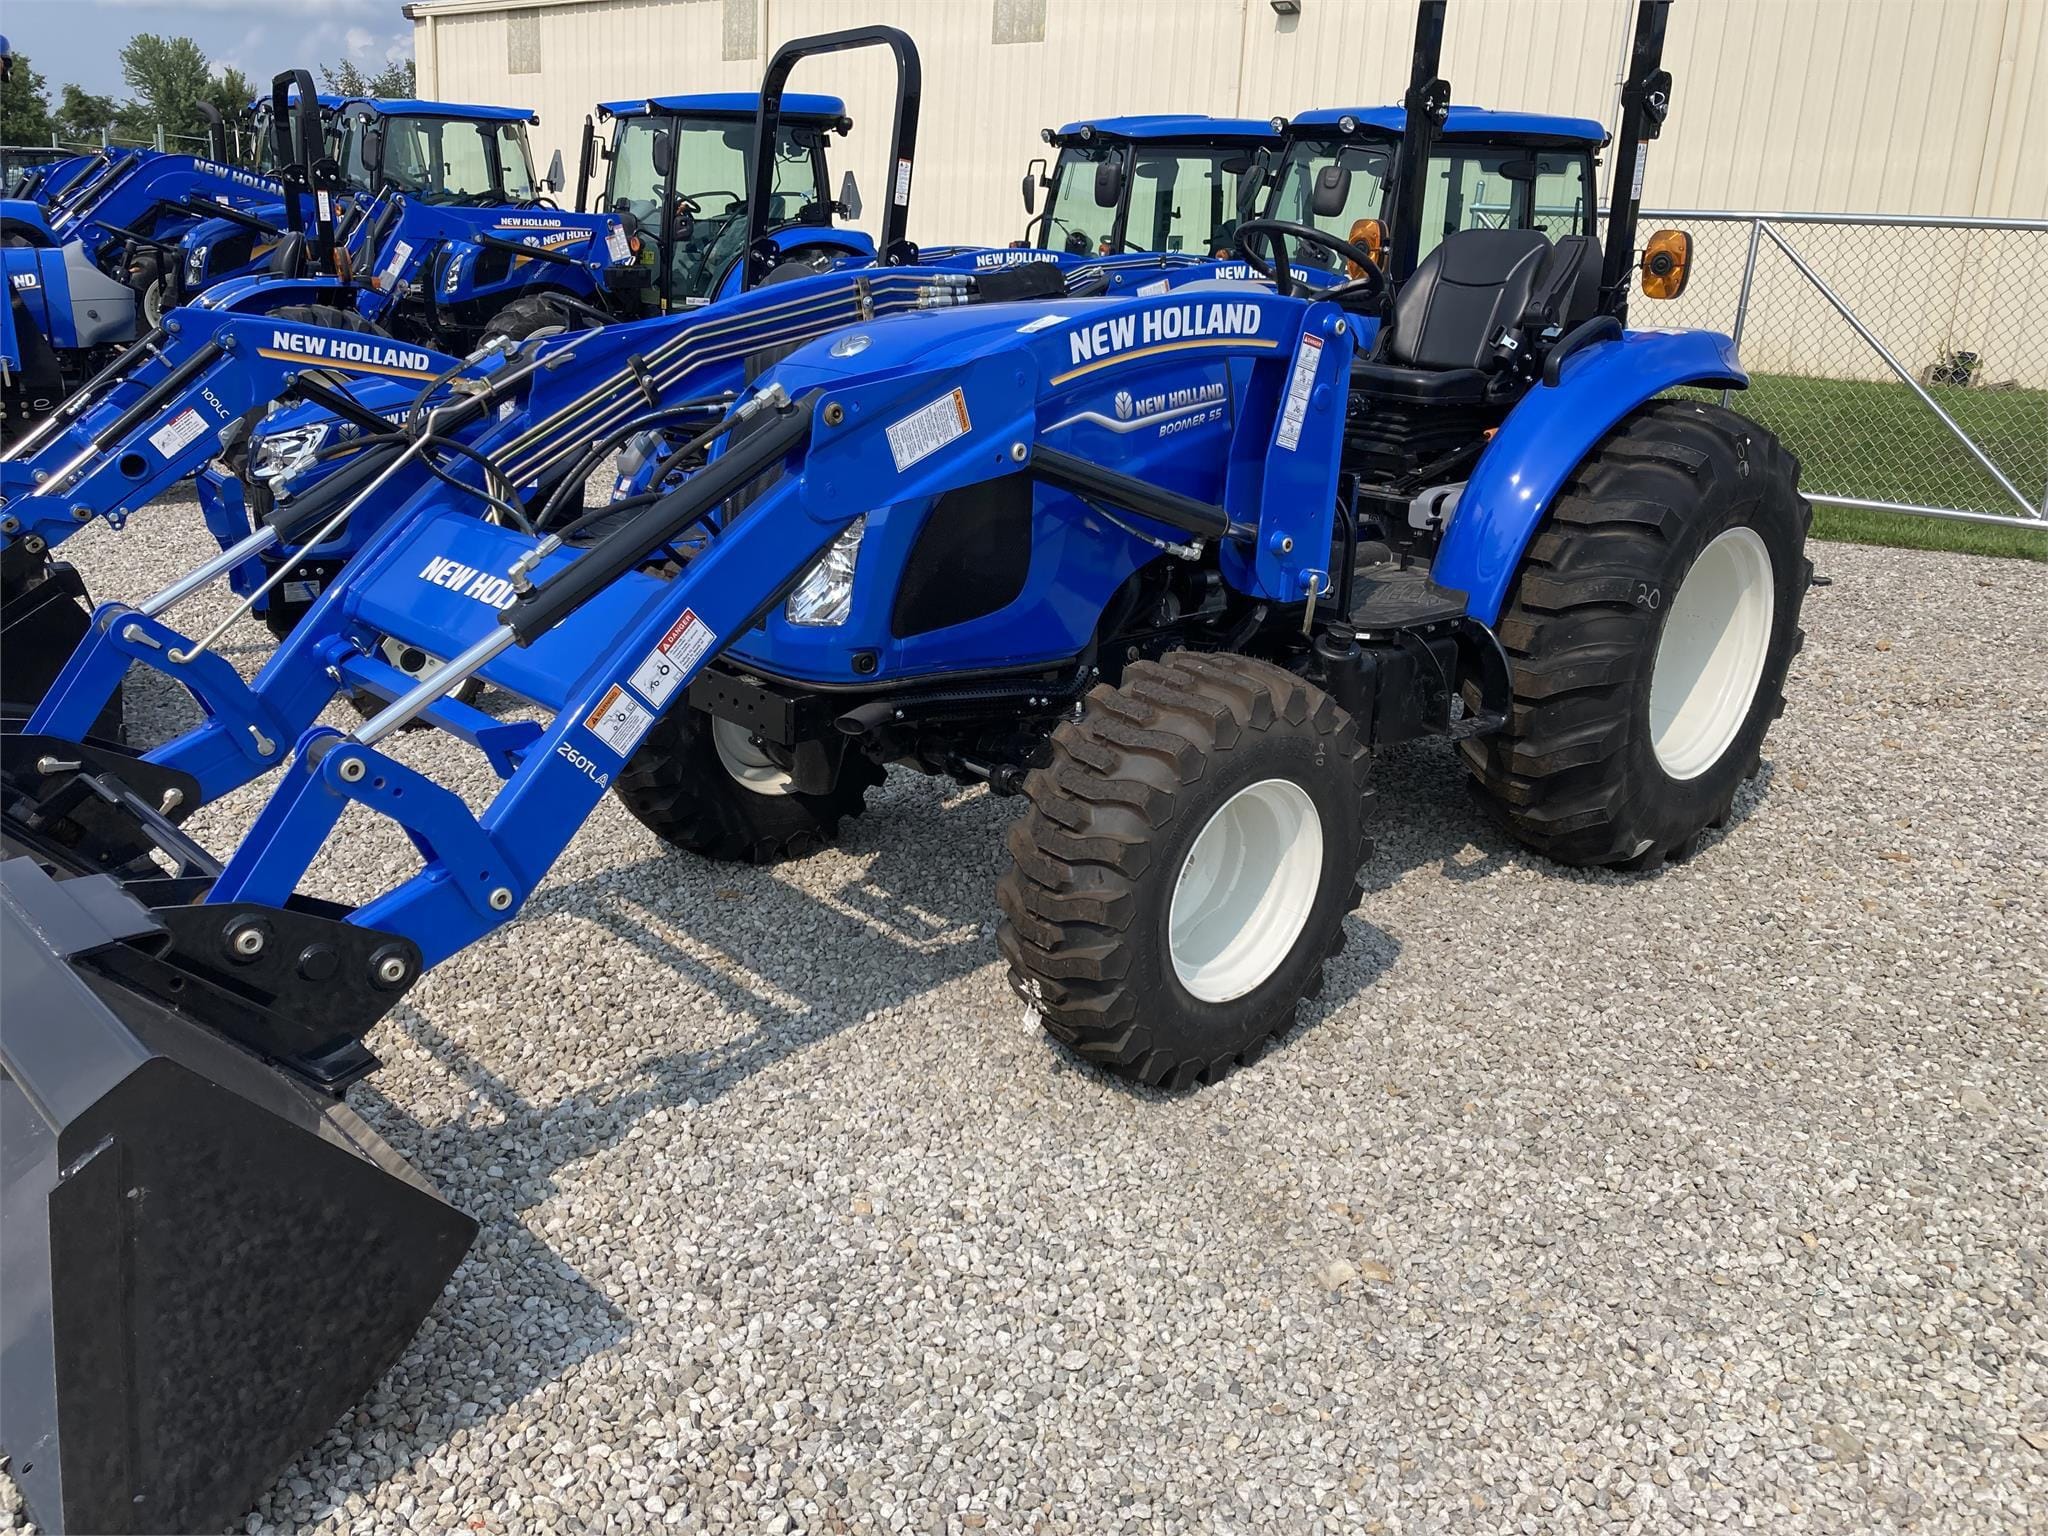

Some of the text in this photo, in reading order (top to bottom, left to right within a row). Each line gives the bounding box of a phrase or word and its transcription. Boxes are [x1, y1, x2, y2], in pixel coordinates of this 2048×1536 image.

[193, 158, 286, 197] NEW HOLLAN
[500, 217, 561, 228] NEW HOLLAND
[543, 231, 565, 246] NEW
[975, 252, 1059, 267] NEW HOLLAND
[1215, 265, 1246, 280] NEW
[1069, 303, 1262, 365] NEW HOLLAND
[272, 330, 430, 371] NEW HOLLAND
[201, 387, 230, 419] 100LC
[1135, 383, 1224, 417] NEW HOLLAND
[1159, 407, 1223, 438] BOOMER 55
[418, 555, 479, 592] NEW
[1637, 583, 1661, 610] 20
[667, 615, 692, 643] DANGER
